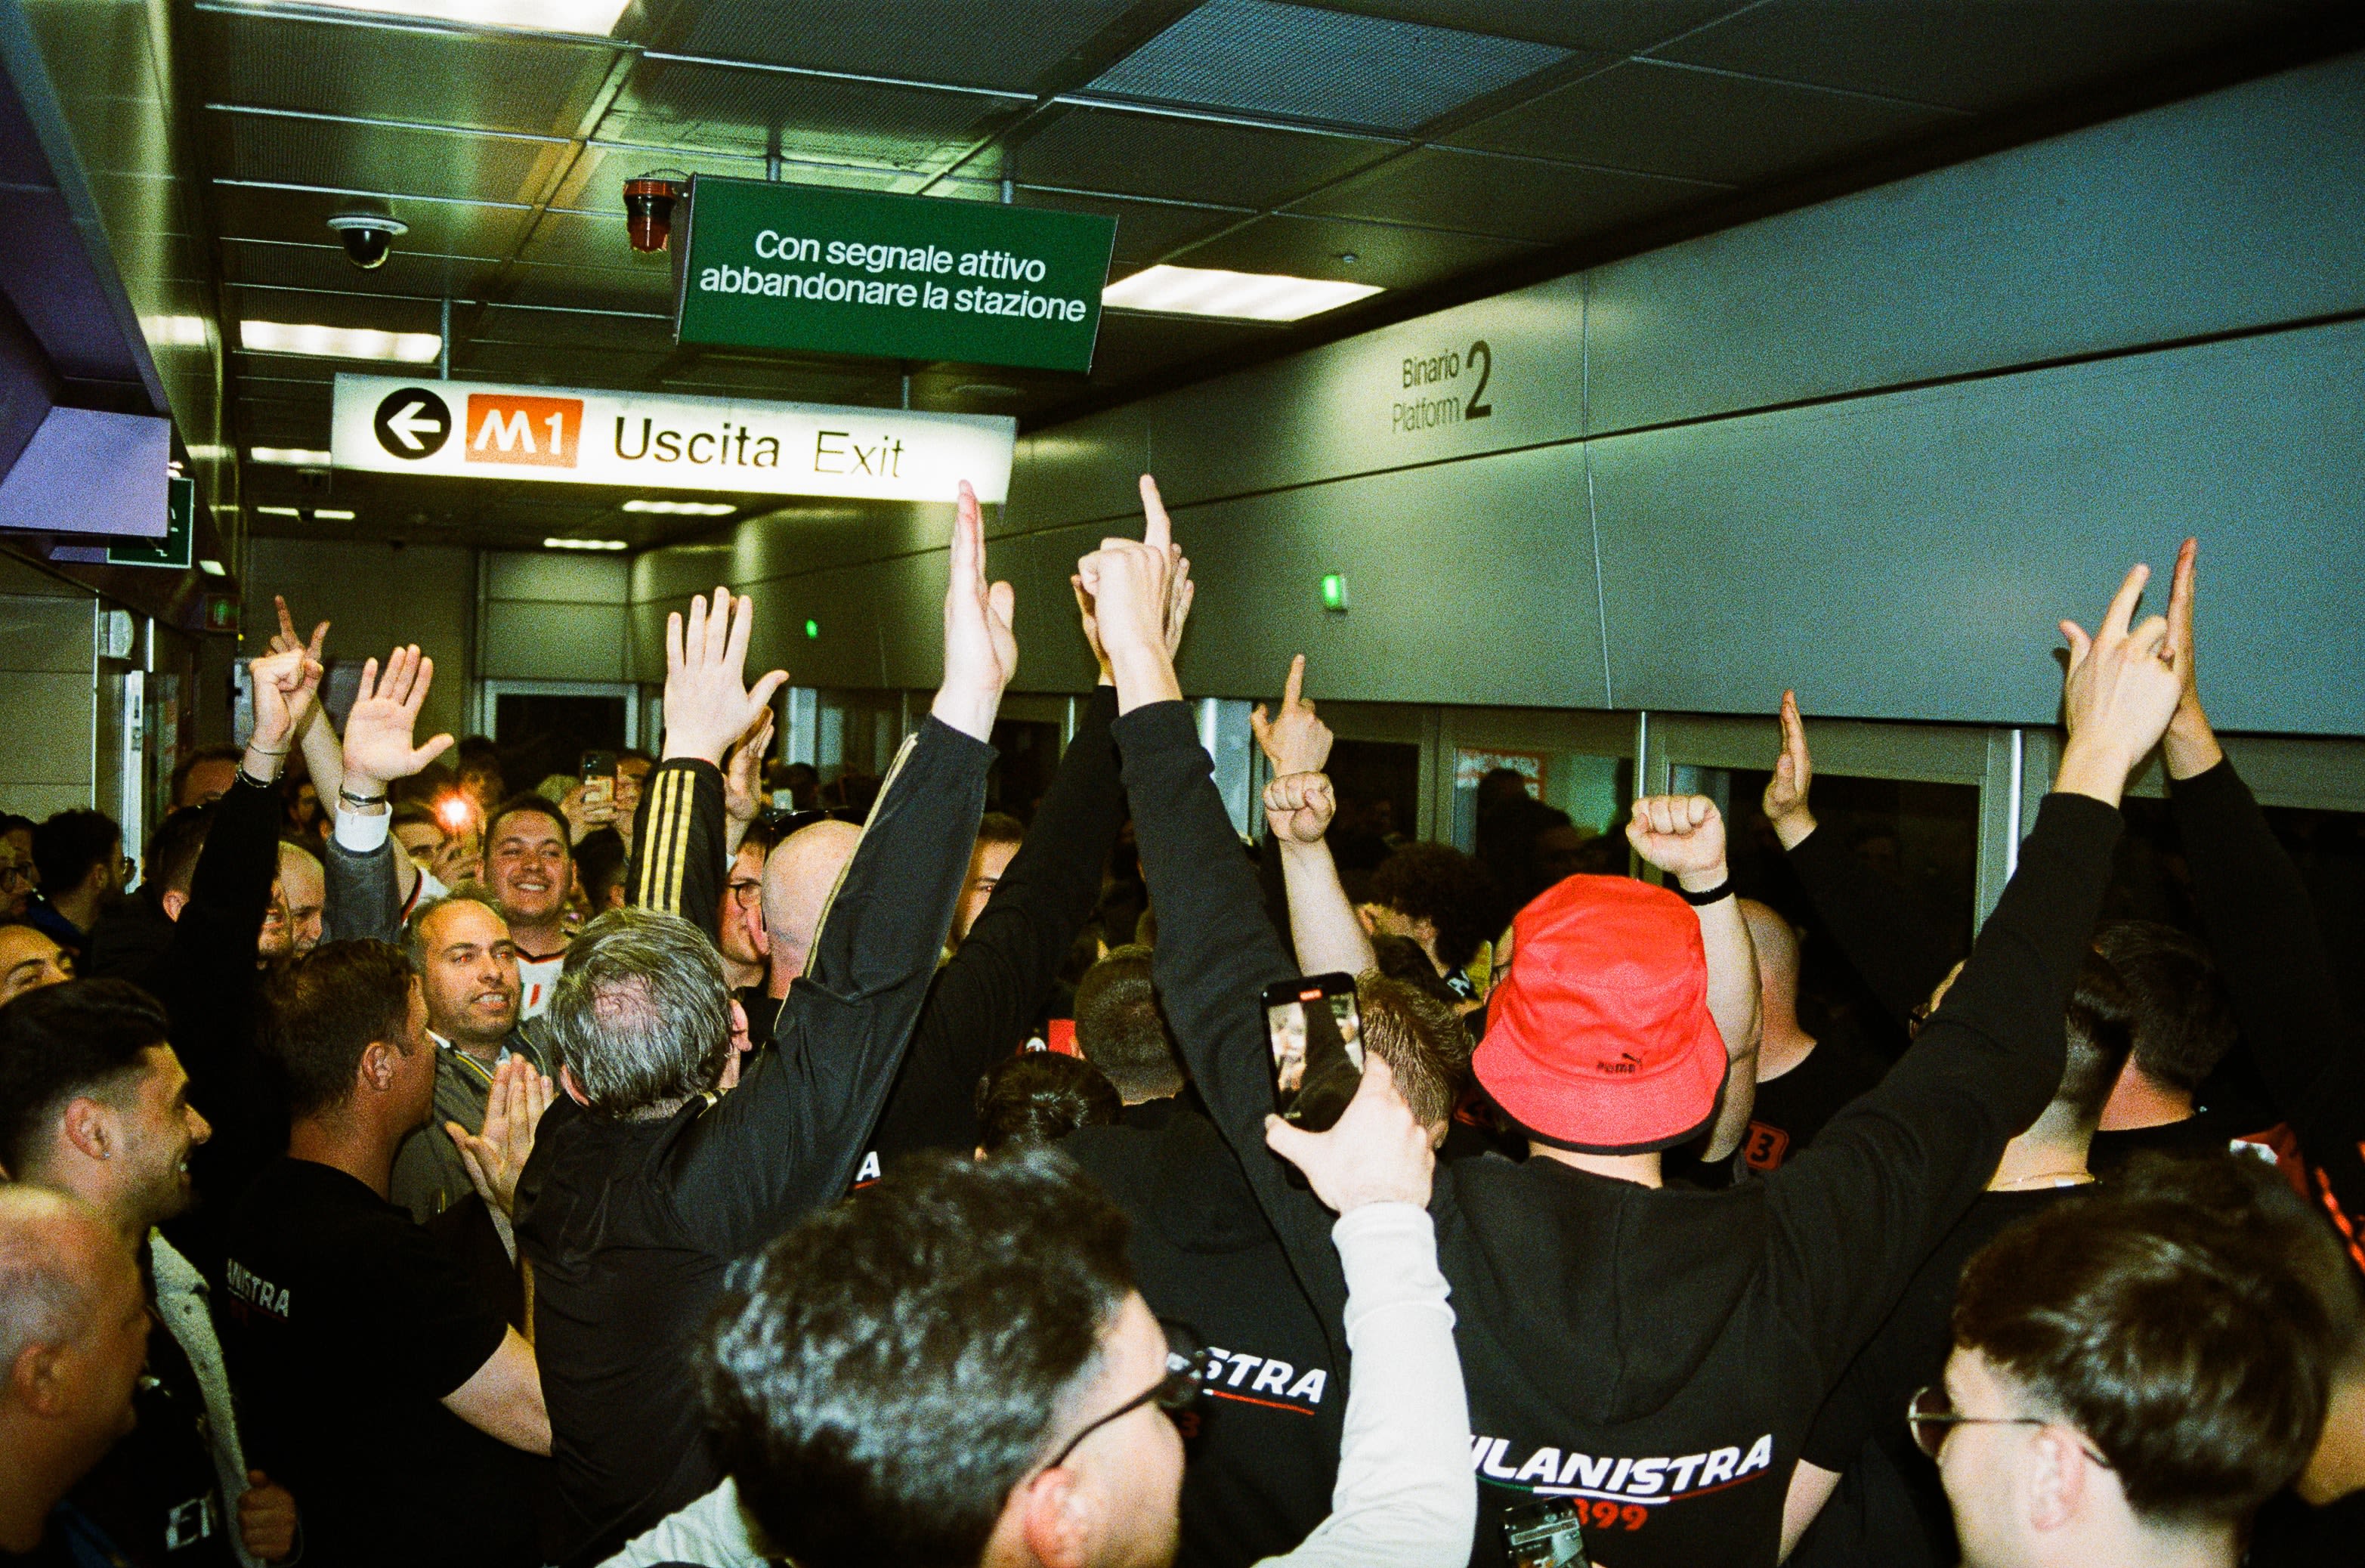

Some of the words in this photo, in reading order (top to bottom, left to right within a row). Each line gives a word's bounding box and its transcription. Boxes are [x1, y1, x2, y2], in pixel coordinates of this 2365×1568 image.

[756, 230, 821, 262] Con
[826, 241, 954, 274] segnale
[958, 249, 1046, 283] attivo
[700, 264, 918, 307] abbandonare
[923, 281, 949, 310] la
[954, 286, 1087, 322] stazione
[1402, 349, 1460, 388] Binario
[1465, 340, 1492, 420] 2
[1392, 397, 1460, 433] Platform
[474, 409, 563, 455] M1
[615, 416, 780, 468] Uscita
[815, 431, 904, 478] Exit
[1750, 1132, 1776, 1163] 3
[1207, 1347, 1327, 1403] STRA
[1470, 1433, 1773, 1495] ILANISTRA
